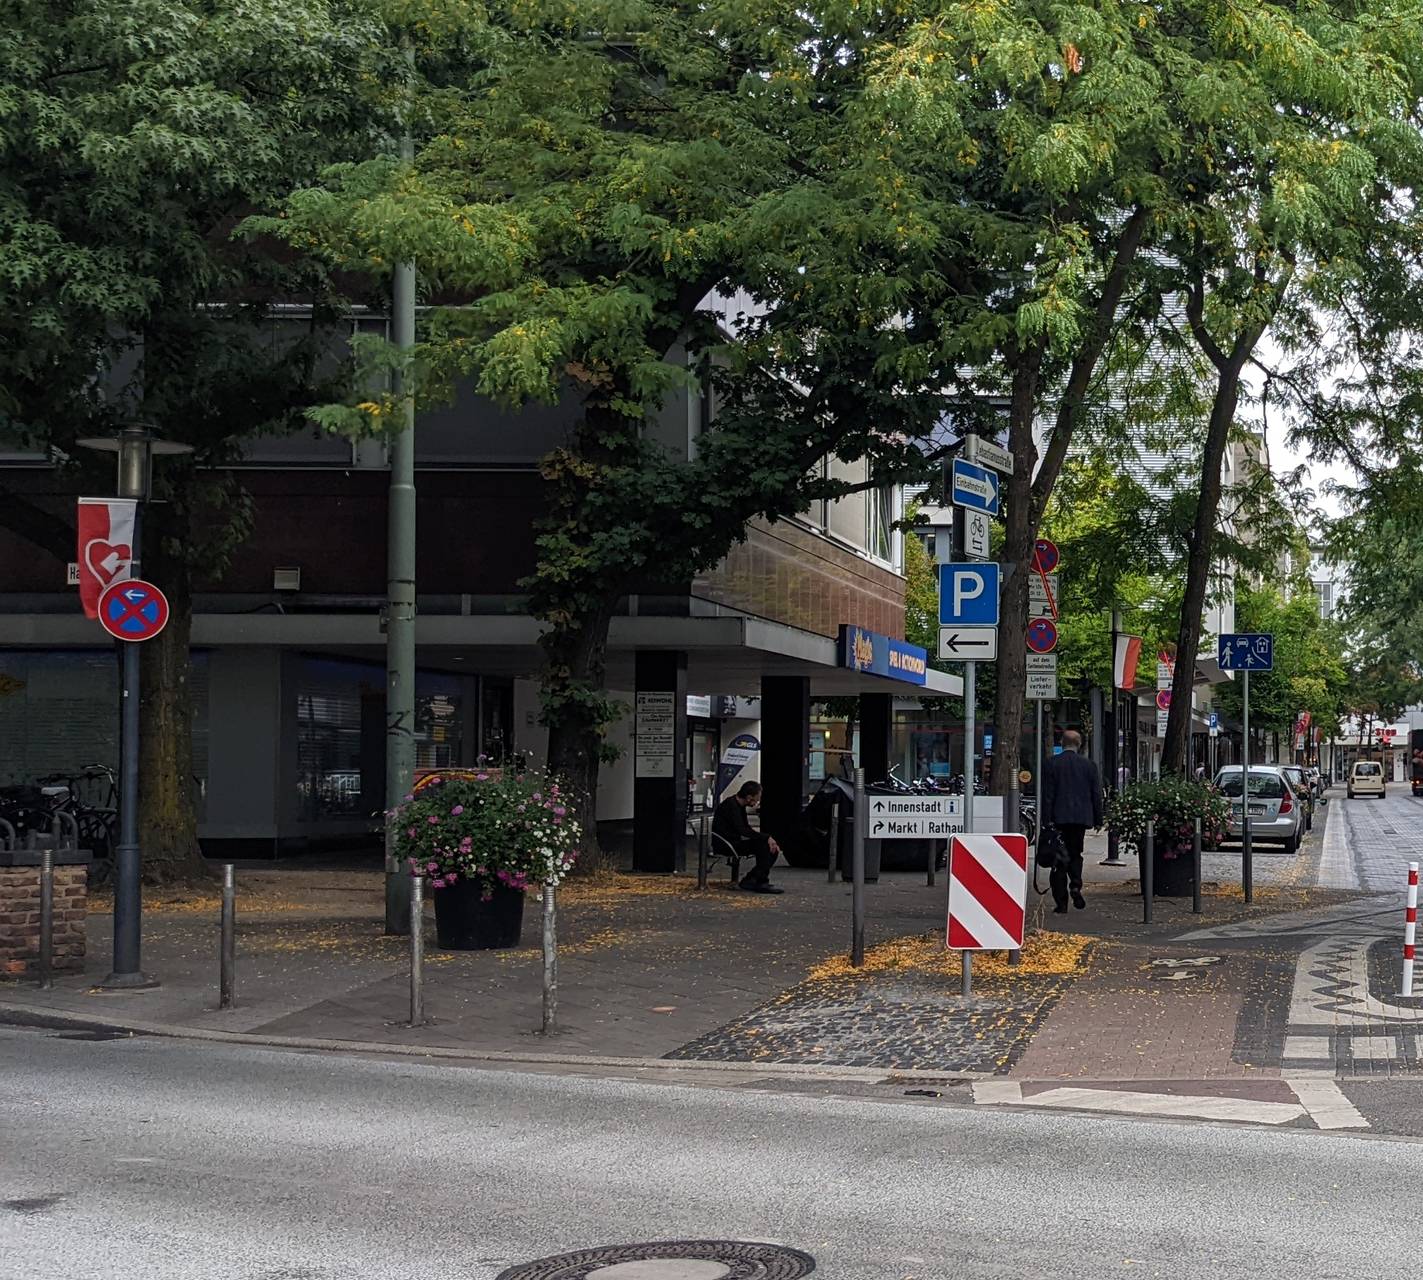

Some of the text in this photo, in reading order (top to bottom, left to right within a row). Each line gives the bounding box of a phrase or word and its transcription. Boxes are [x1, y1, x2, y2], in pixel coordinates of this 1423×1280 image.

[956, 476, 987, 495] Einbahnstraße
[953, 571, 985, 616] P
[888, 801, 941, 812] Innenstadt
[888, 822, 963, 833] Markt Rathau
